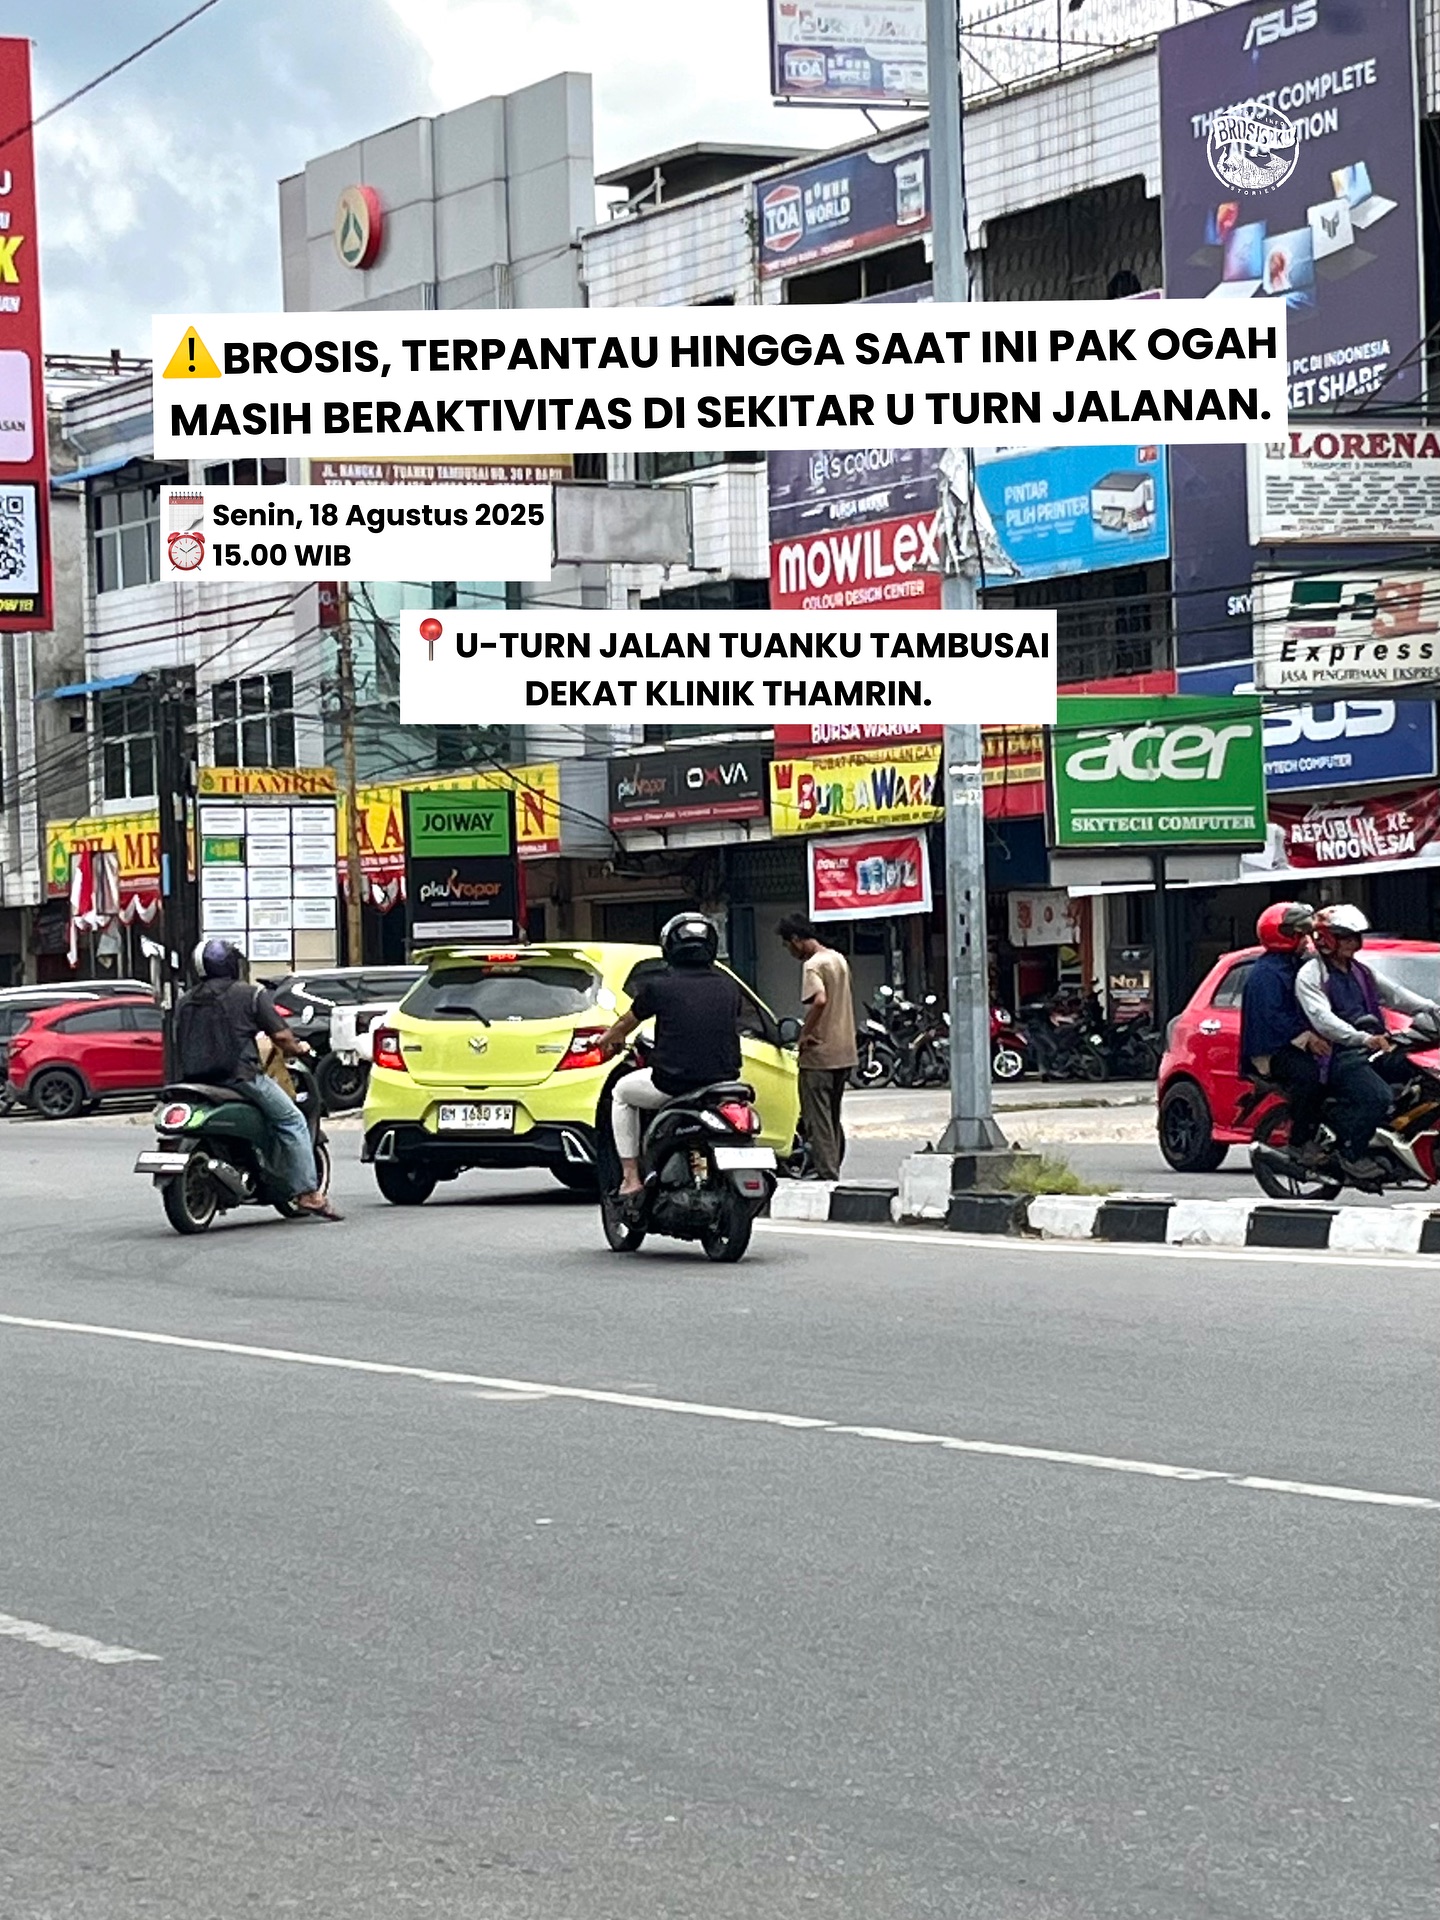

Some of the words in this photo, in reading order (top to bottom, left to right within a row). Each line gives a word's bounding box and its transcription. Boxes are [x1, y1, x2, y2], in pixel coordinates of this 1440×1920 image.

[1243, 0, 1318, 51] ASUS
[788, 61, 823, 77] TOA
[1278, 58, 1377, 112] COMPLETE
[766, 202, 800, 234] TOA
[805, 196, 851, 226] WORLD
[1323, 338, 1391, 369] INDONESIA
[1289, 432, 1440, 460] LORENA
[1004, 479, 1049, 507] PINTAR
[1037, 495, 1090, 523] PRINTER
[884, 579, 925, 599] CENTER
[1280, 640, 1433, 666] Express
[1281, 670, 1308, 684] JASA
[811, 724, 861, 744] BURSA
[1065, 725, 1254, 782] acer
[1298, 753, 1352, 772] COMPUTER
[218, 776, 336, 792] THAMRIN
[686, 762, 749, 789] OXVA
[797, 774, 871, 820] BURSA
[870, 766, 936, 811] WARN
[421, 812, 495, 832] JOIWAY
[1071, 817, 1153, 832] SKYTECH
[1157, 816, 1256, 832] COMPUTER
[1291, 817, 1378, 844] REPUBLIK
[1315, 831, 1417, 862] INDONESIA
